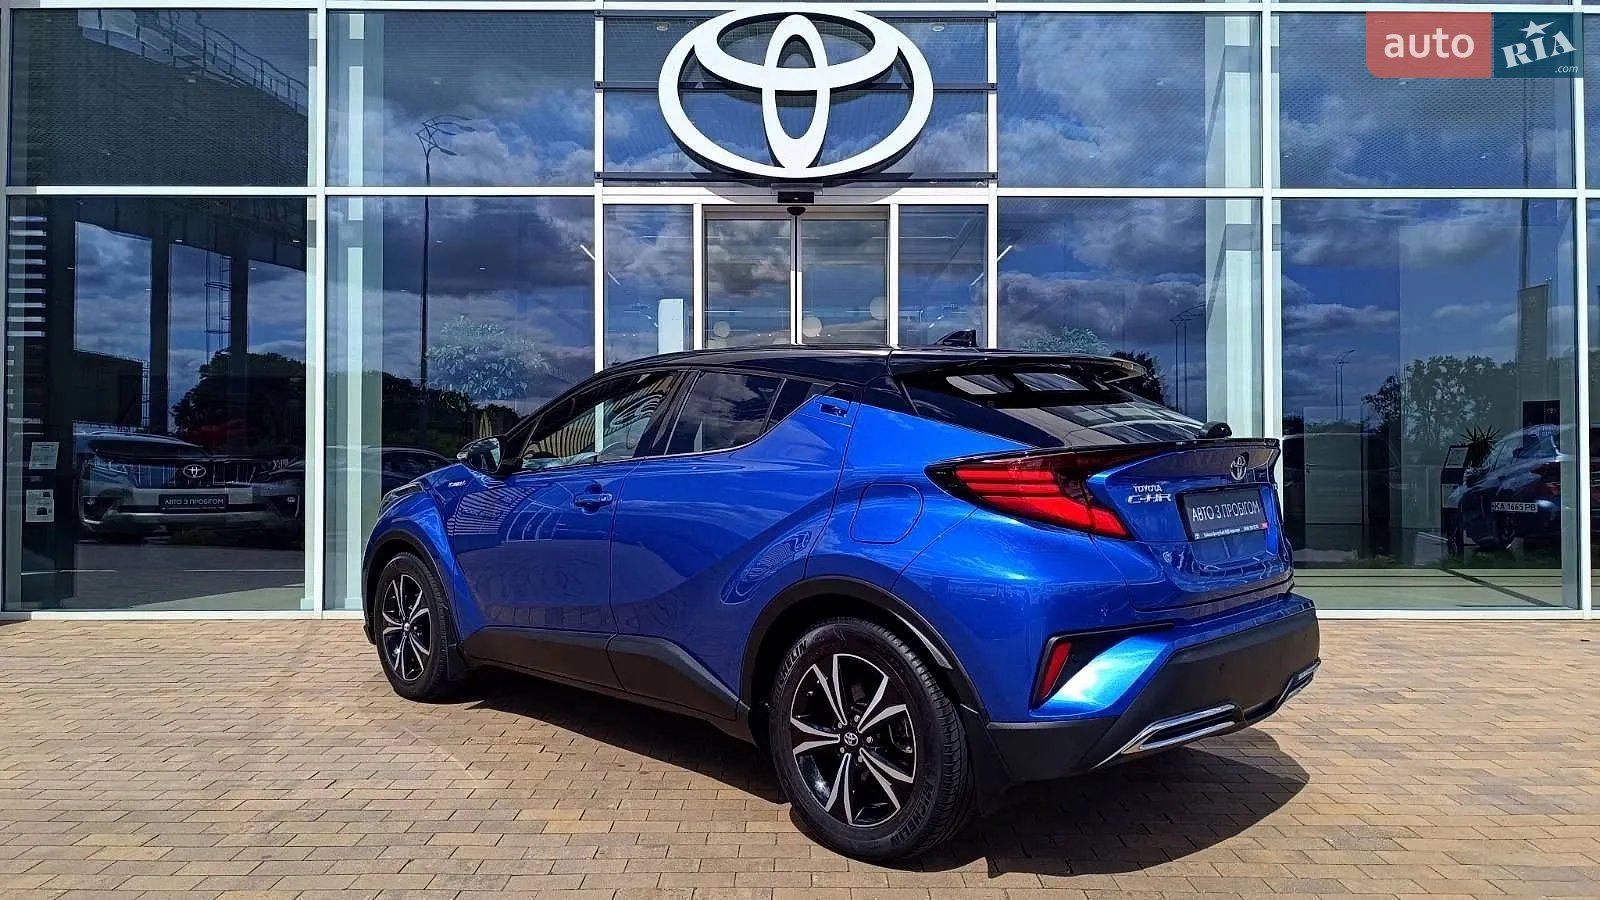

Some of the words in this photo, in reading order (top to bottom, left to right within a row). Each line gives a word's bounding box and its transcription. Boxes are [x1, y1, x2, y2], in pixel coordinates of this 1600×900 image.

[1132, 485, 1163, 493] TOYOTA
[1127, 493, 1172, 504] C-HR
[1192, 505, 1214, 522] АВТО
[1221, 500, 1260, 518] ПРОБІГОМ
